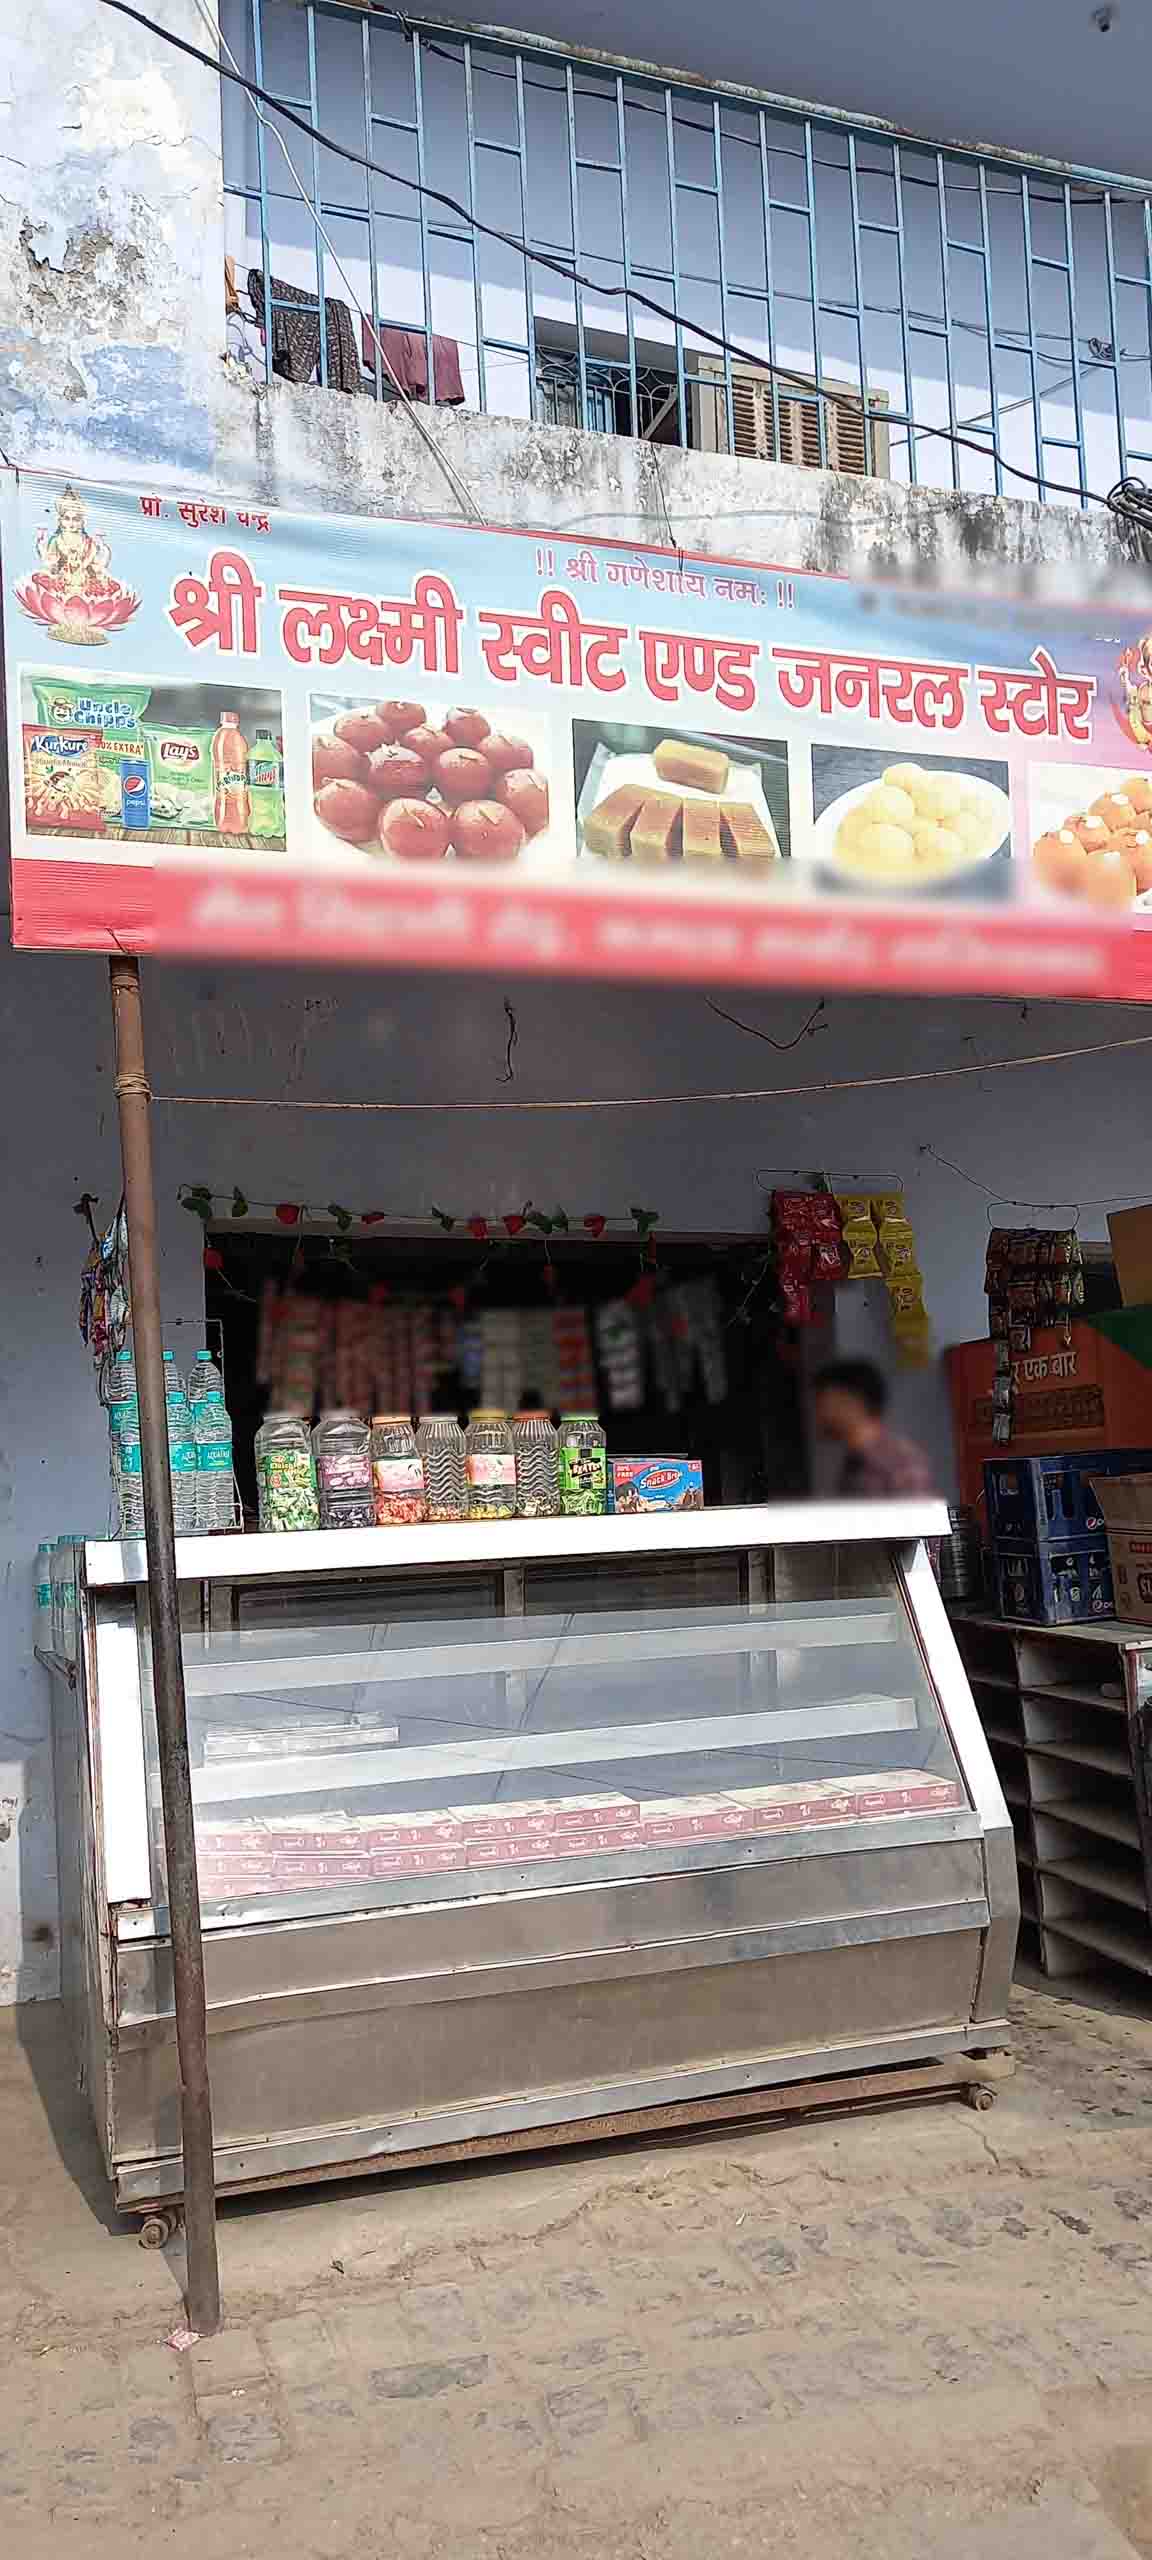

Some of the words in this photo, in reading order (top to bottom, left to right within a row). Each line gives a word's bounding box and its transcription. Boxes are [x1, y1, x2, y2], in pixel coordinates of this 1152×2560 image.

[176, 496, 226, 528] सुरेश
[236, 511, 271, 532] चन्द्र
[566, 550, 600, 582] श्री
[605, 556, 704, 598] गणेशाय
[168, 550, 263, 653] श्री
[278, 574, 465, 674] लक्ष्मी
[478, 589, 629, 692] स्वीट
[638, 630, 761, 712] एण्ड
[771, 647, 970, 729] जनरल
[977, 650, 1095, 740] स्टोर
[73, 710, 138, 729] Chipps
